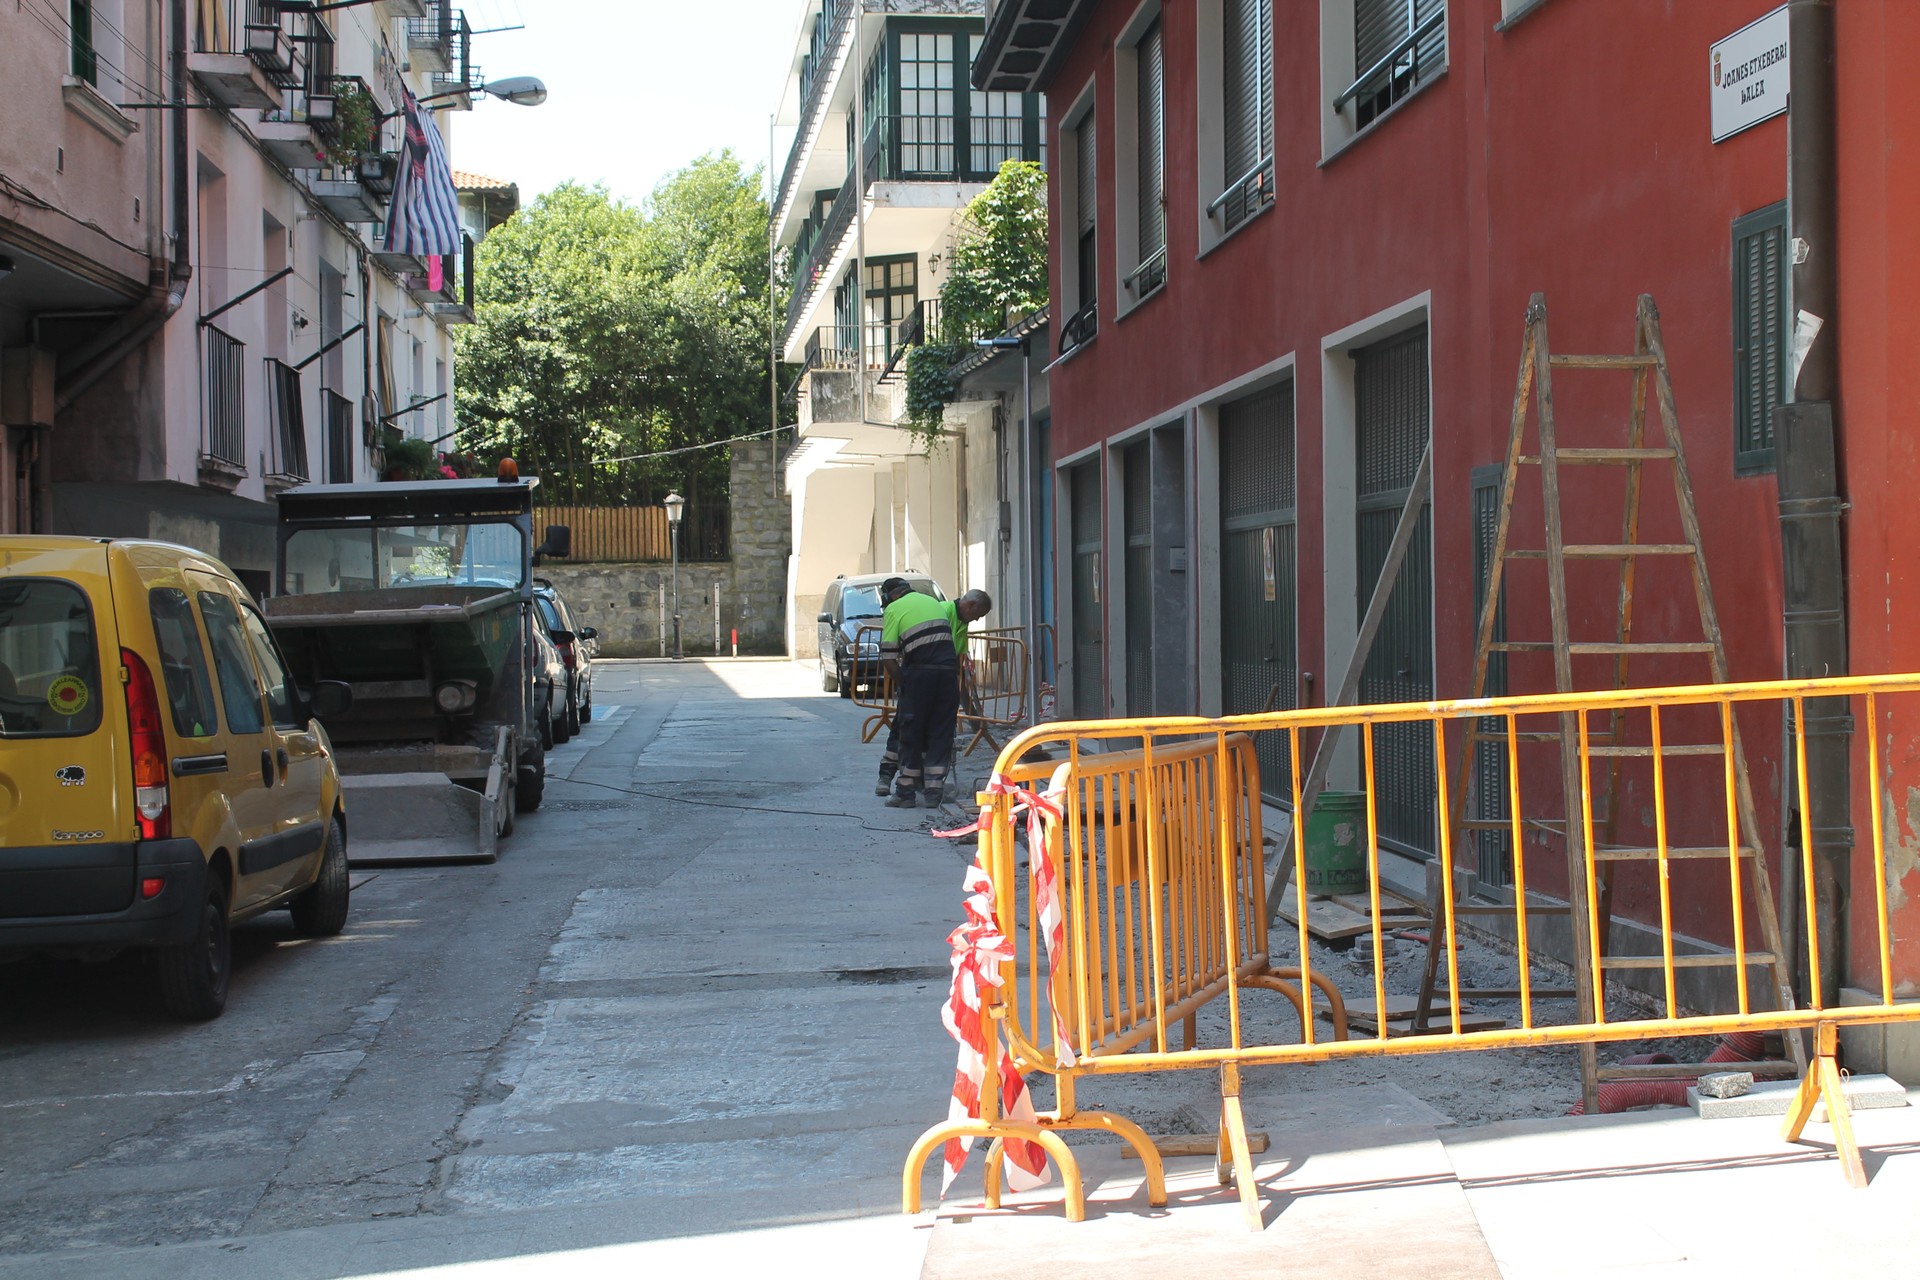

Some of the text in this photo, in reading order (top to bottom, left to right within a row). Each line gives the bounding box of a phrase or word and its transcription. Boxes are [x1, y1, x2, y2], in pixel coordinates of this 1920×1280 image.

[1723, 42, 1787, 88] JOANES ETXEBERRI
[53, 830, 104, 841] Kangoo
